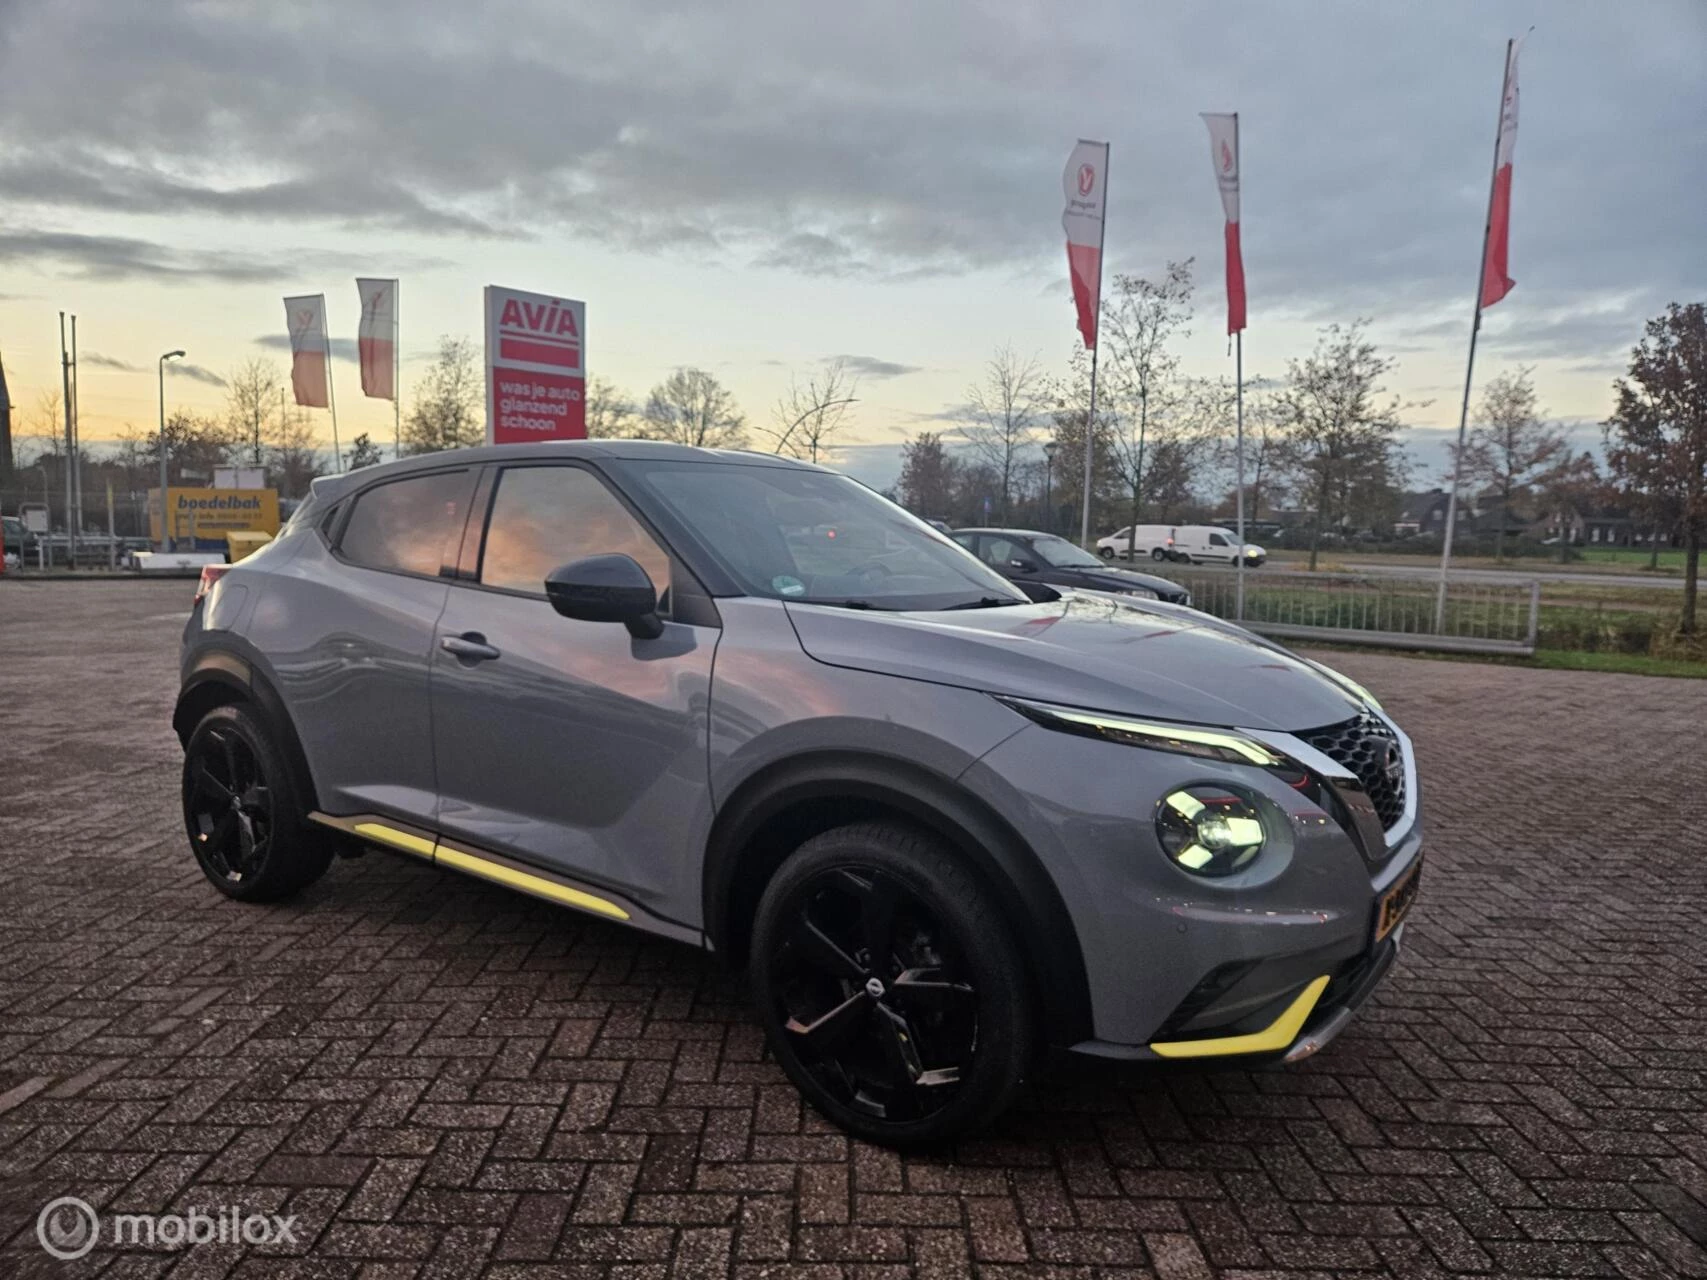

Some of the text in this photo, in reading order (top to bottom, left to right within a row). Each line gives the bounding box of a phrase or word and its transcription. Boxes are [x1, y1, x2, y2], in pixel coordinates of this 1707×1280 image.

[500, 381, 581, 400] was je auto
[500, 397, 568, 416] glanzend
[501, 414, 557, 431] schoon
[178, 494, 261, 509] boedelbak
